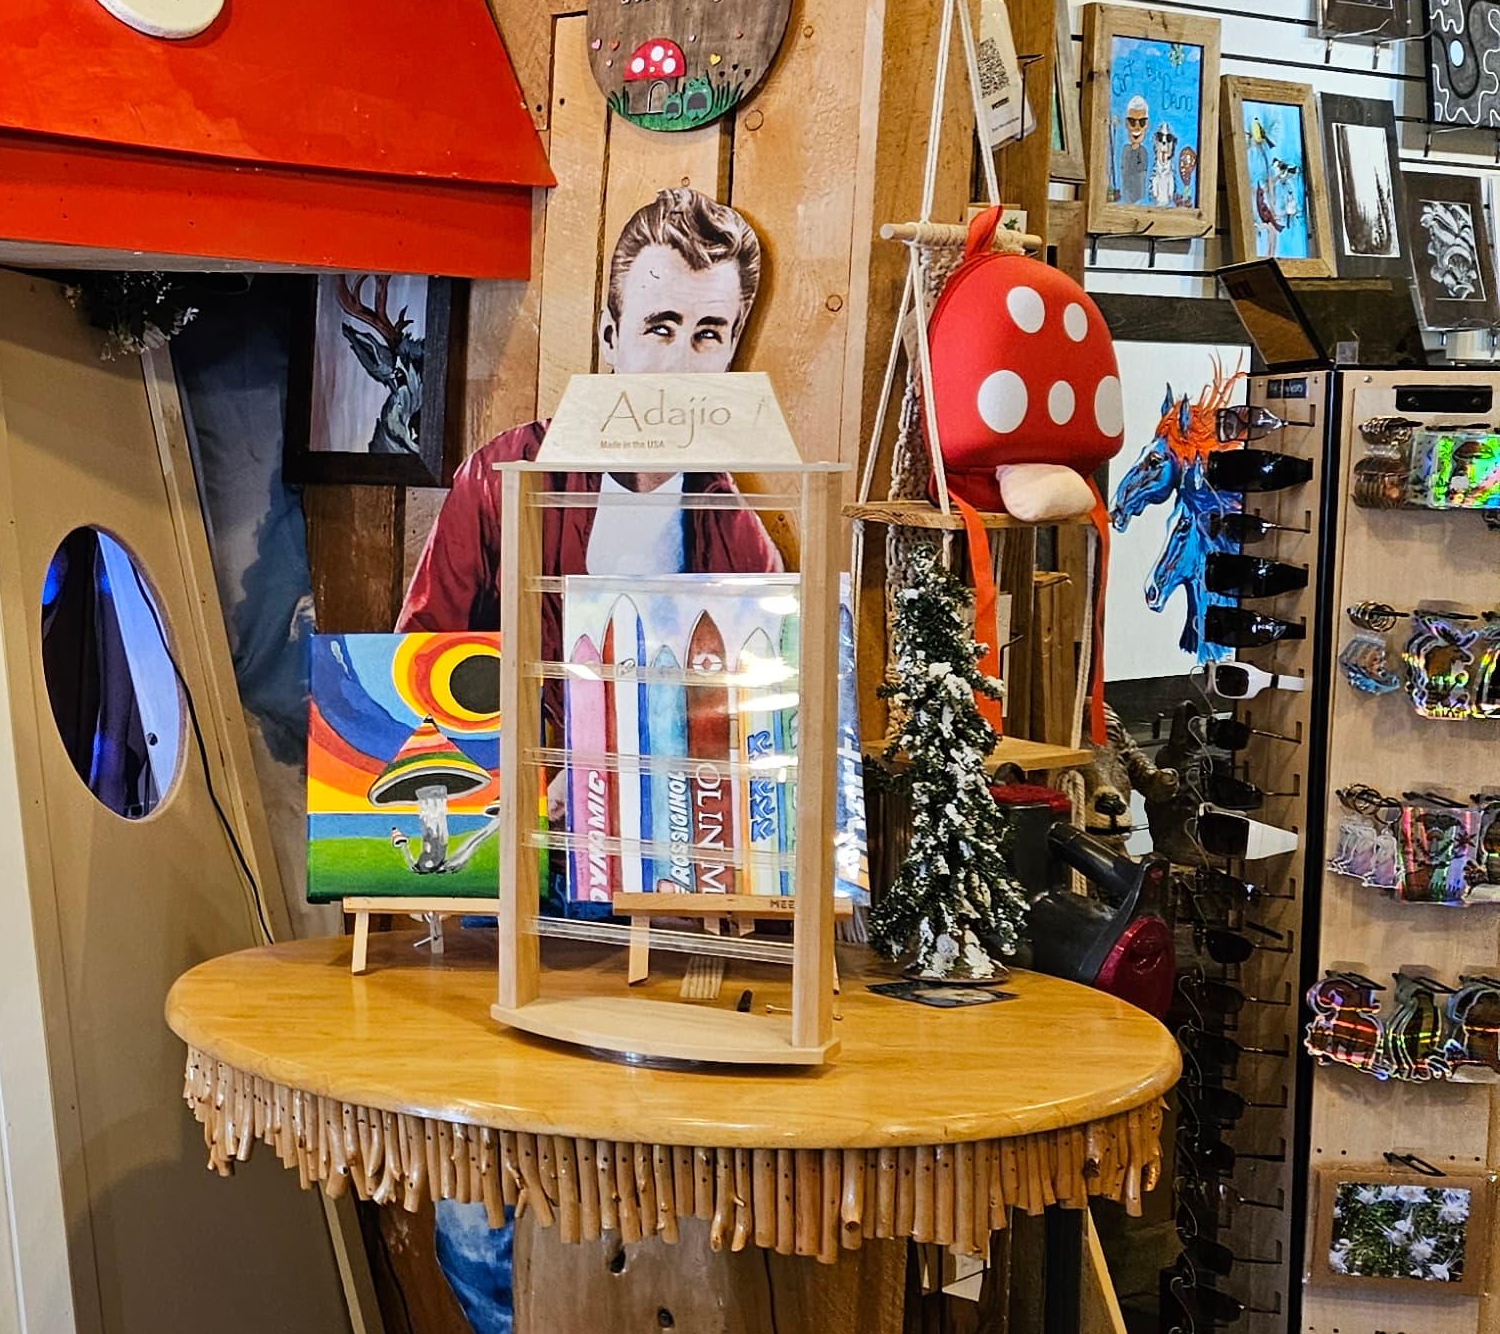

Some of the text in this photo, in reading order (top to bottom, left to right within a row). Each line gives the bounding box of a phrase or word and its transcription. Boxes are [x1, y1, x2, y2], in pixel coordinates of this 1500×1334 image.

[600, 389, 732, 449] Adajio
[600, 439, 666, 449] Made in the USA
[587, 770, 608, 902] DYNAMIC
[696, 762, 725, 852] OLIN
